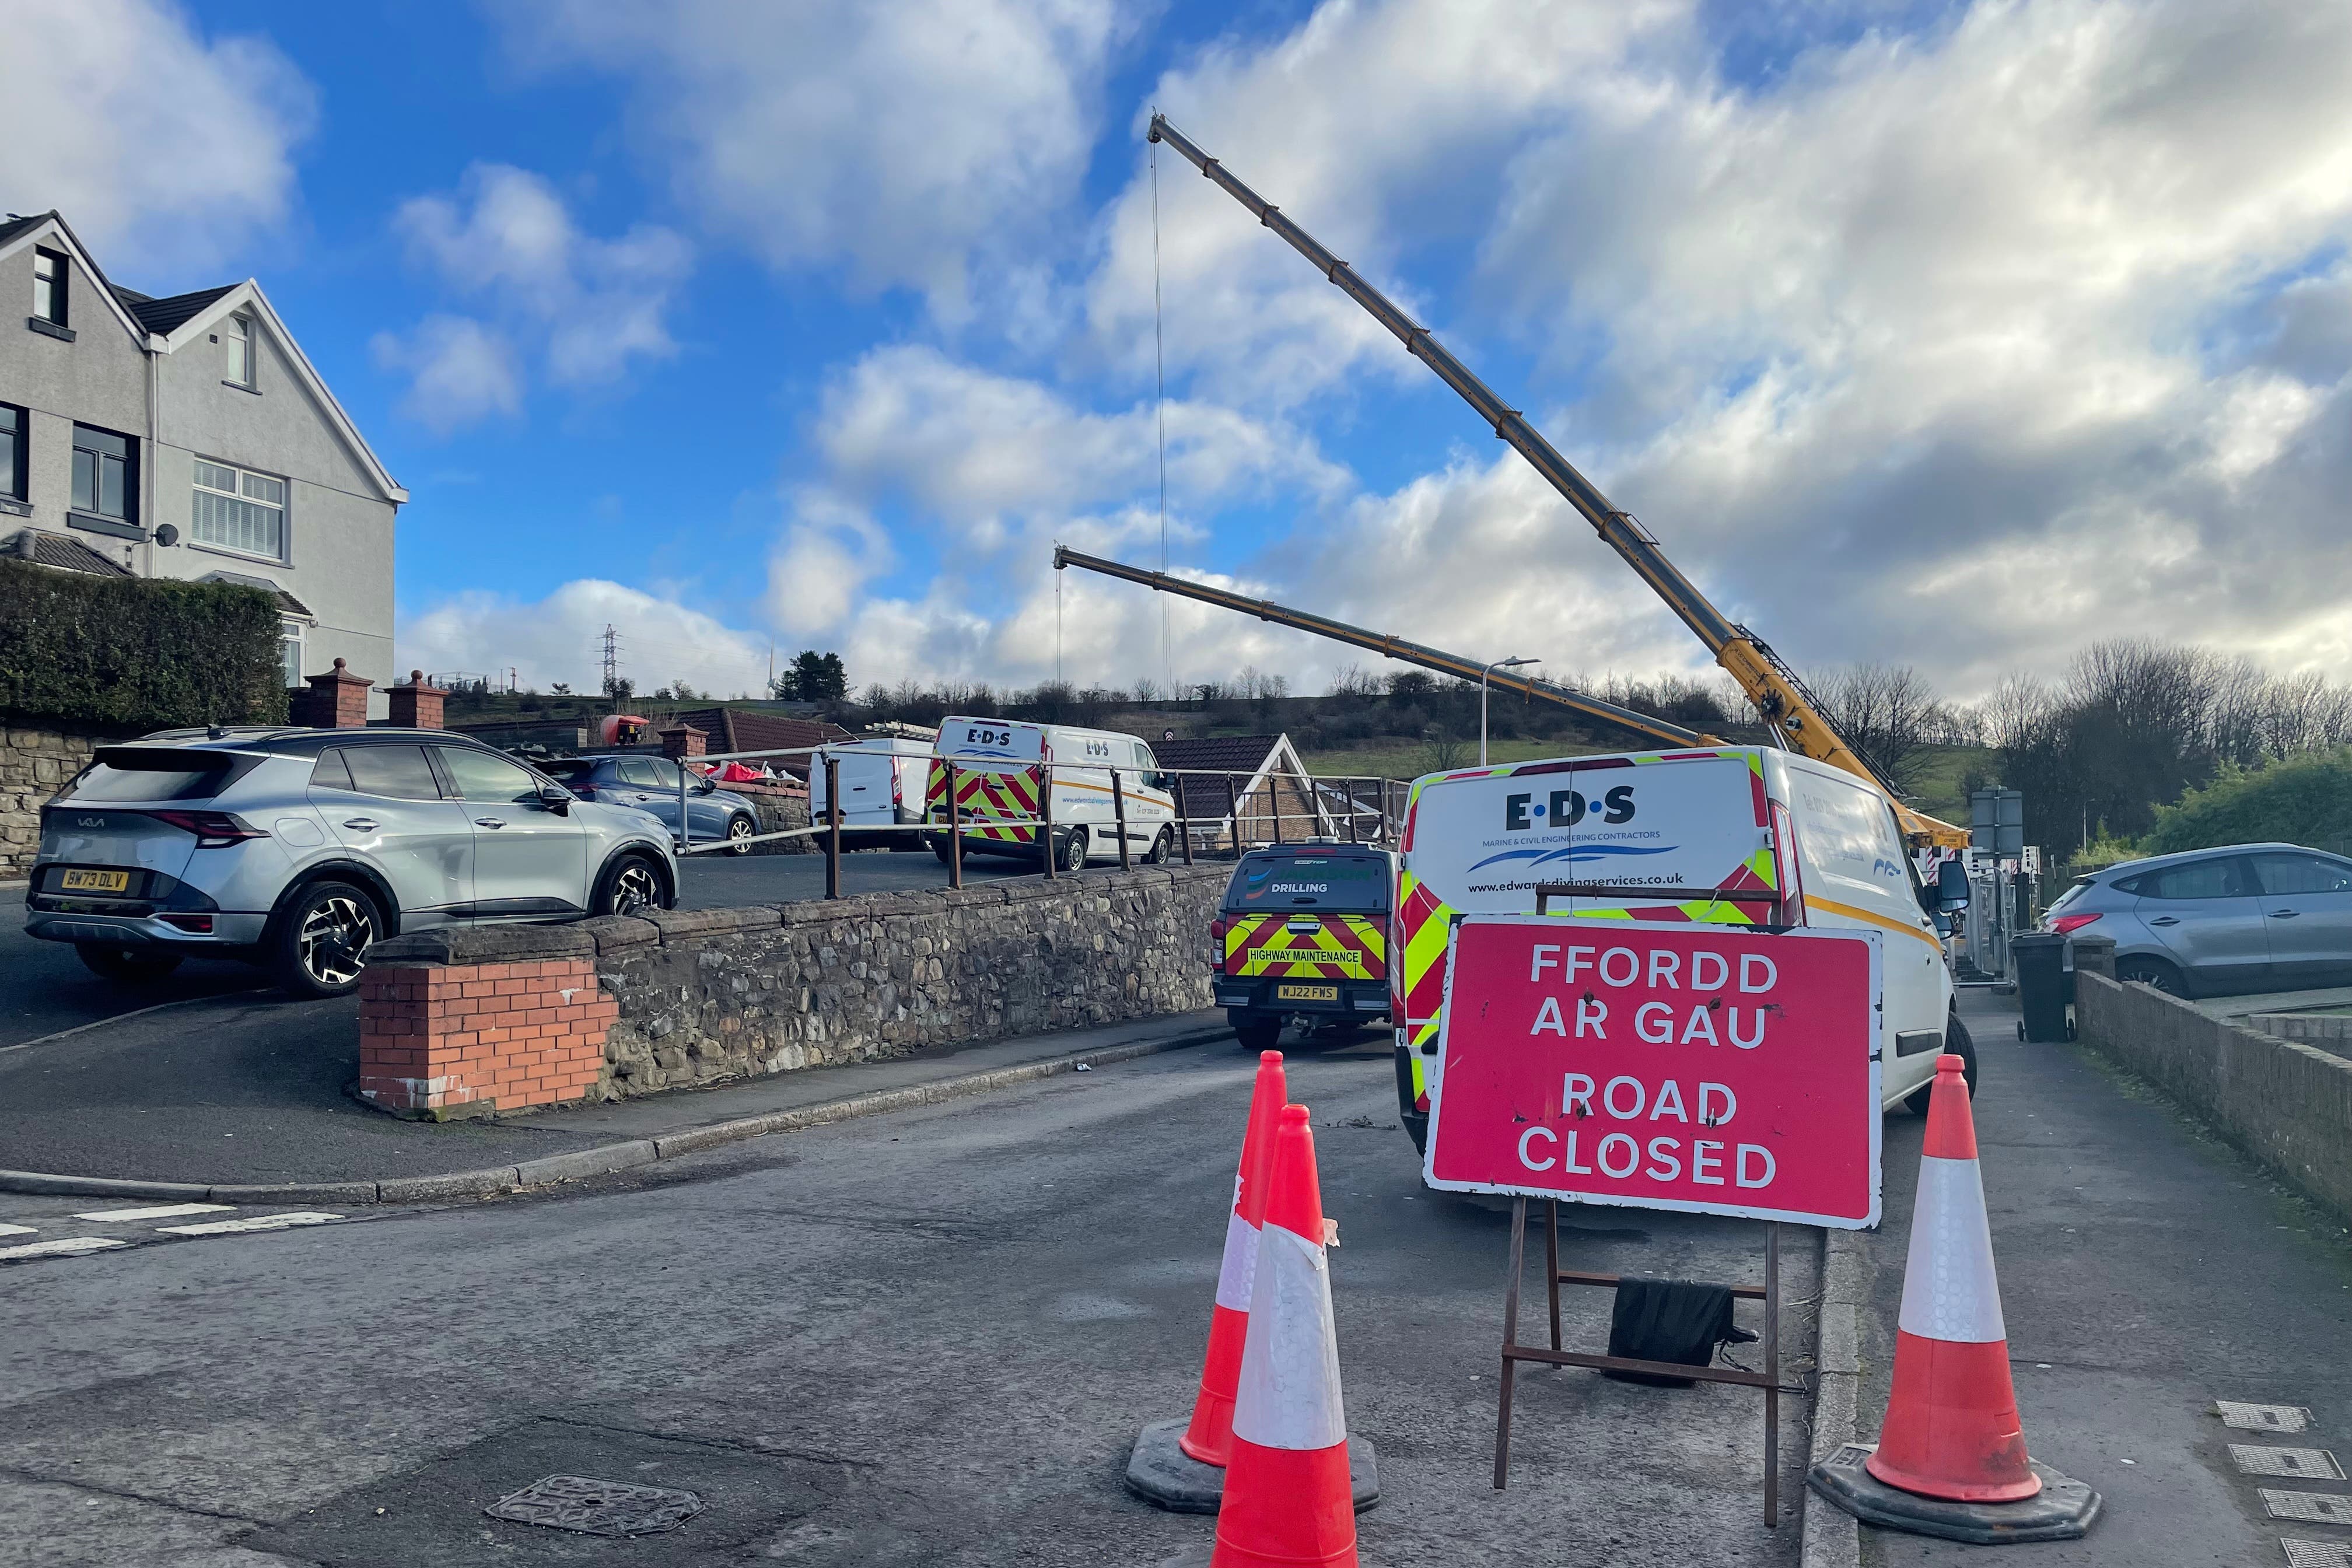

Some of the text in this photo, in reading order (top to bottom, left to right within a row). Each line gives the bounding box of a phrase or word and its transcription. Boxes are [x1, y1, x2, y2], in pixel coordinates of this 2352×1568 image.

[1483, 838, 1512, 847] MARINE
[1521, 836, 1541, 845] CIVIL
[1542, 833, 1597, 844] ENGINEERING
[1598, 831, 1661, 841] CONTRACTORS
[1271, 883, 1328, 892] DRILLING
[1250, 950, 1359, 963] HIGHWAY MAINTENANCE
[1530, 944, 1777, 993] FFORDD
[1283, 986, 1333, 998] WJ22 FWS
[1530, 996, 1765, 1049] AR GAU
[1562, 1072, 1737, 1125] ROAD
[1518, 1126, 1776, 1189] CLOSED
